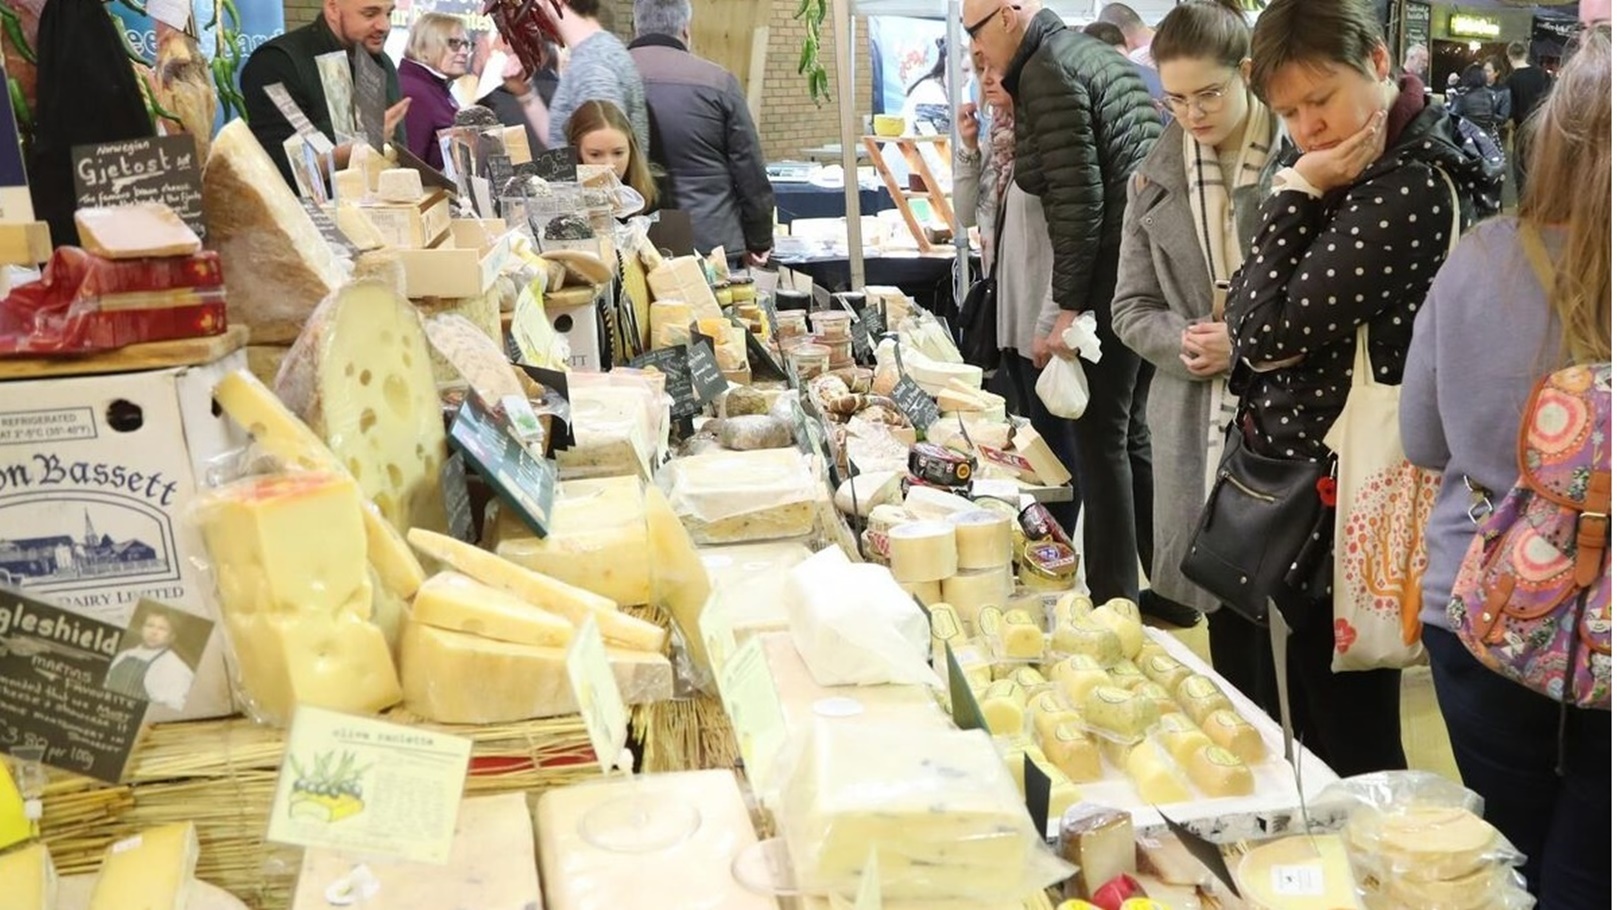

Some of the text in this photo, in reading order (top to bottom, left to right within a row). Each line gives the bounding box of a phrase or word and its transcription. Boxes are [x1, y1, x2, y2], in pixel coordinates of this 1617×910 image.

[96, 140, 150, 156] Norwegian
[78, 146, 172, 186] Gjetost
[33, 453, 178, 507] Bassett
[116, 586, 185, 605] LIITED
[70, 746, 94, 771] 100g
